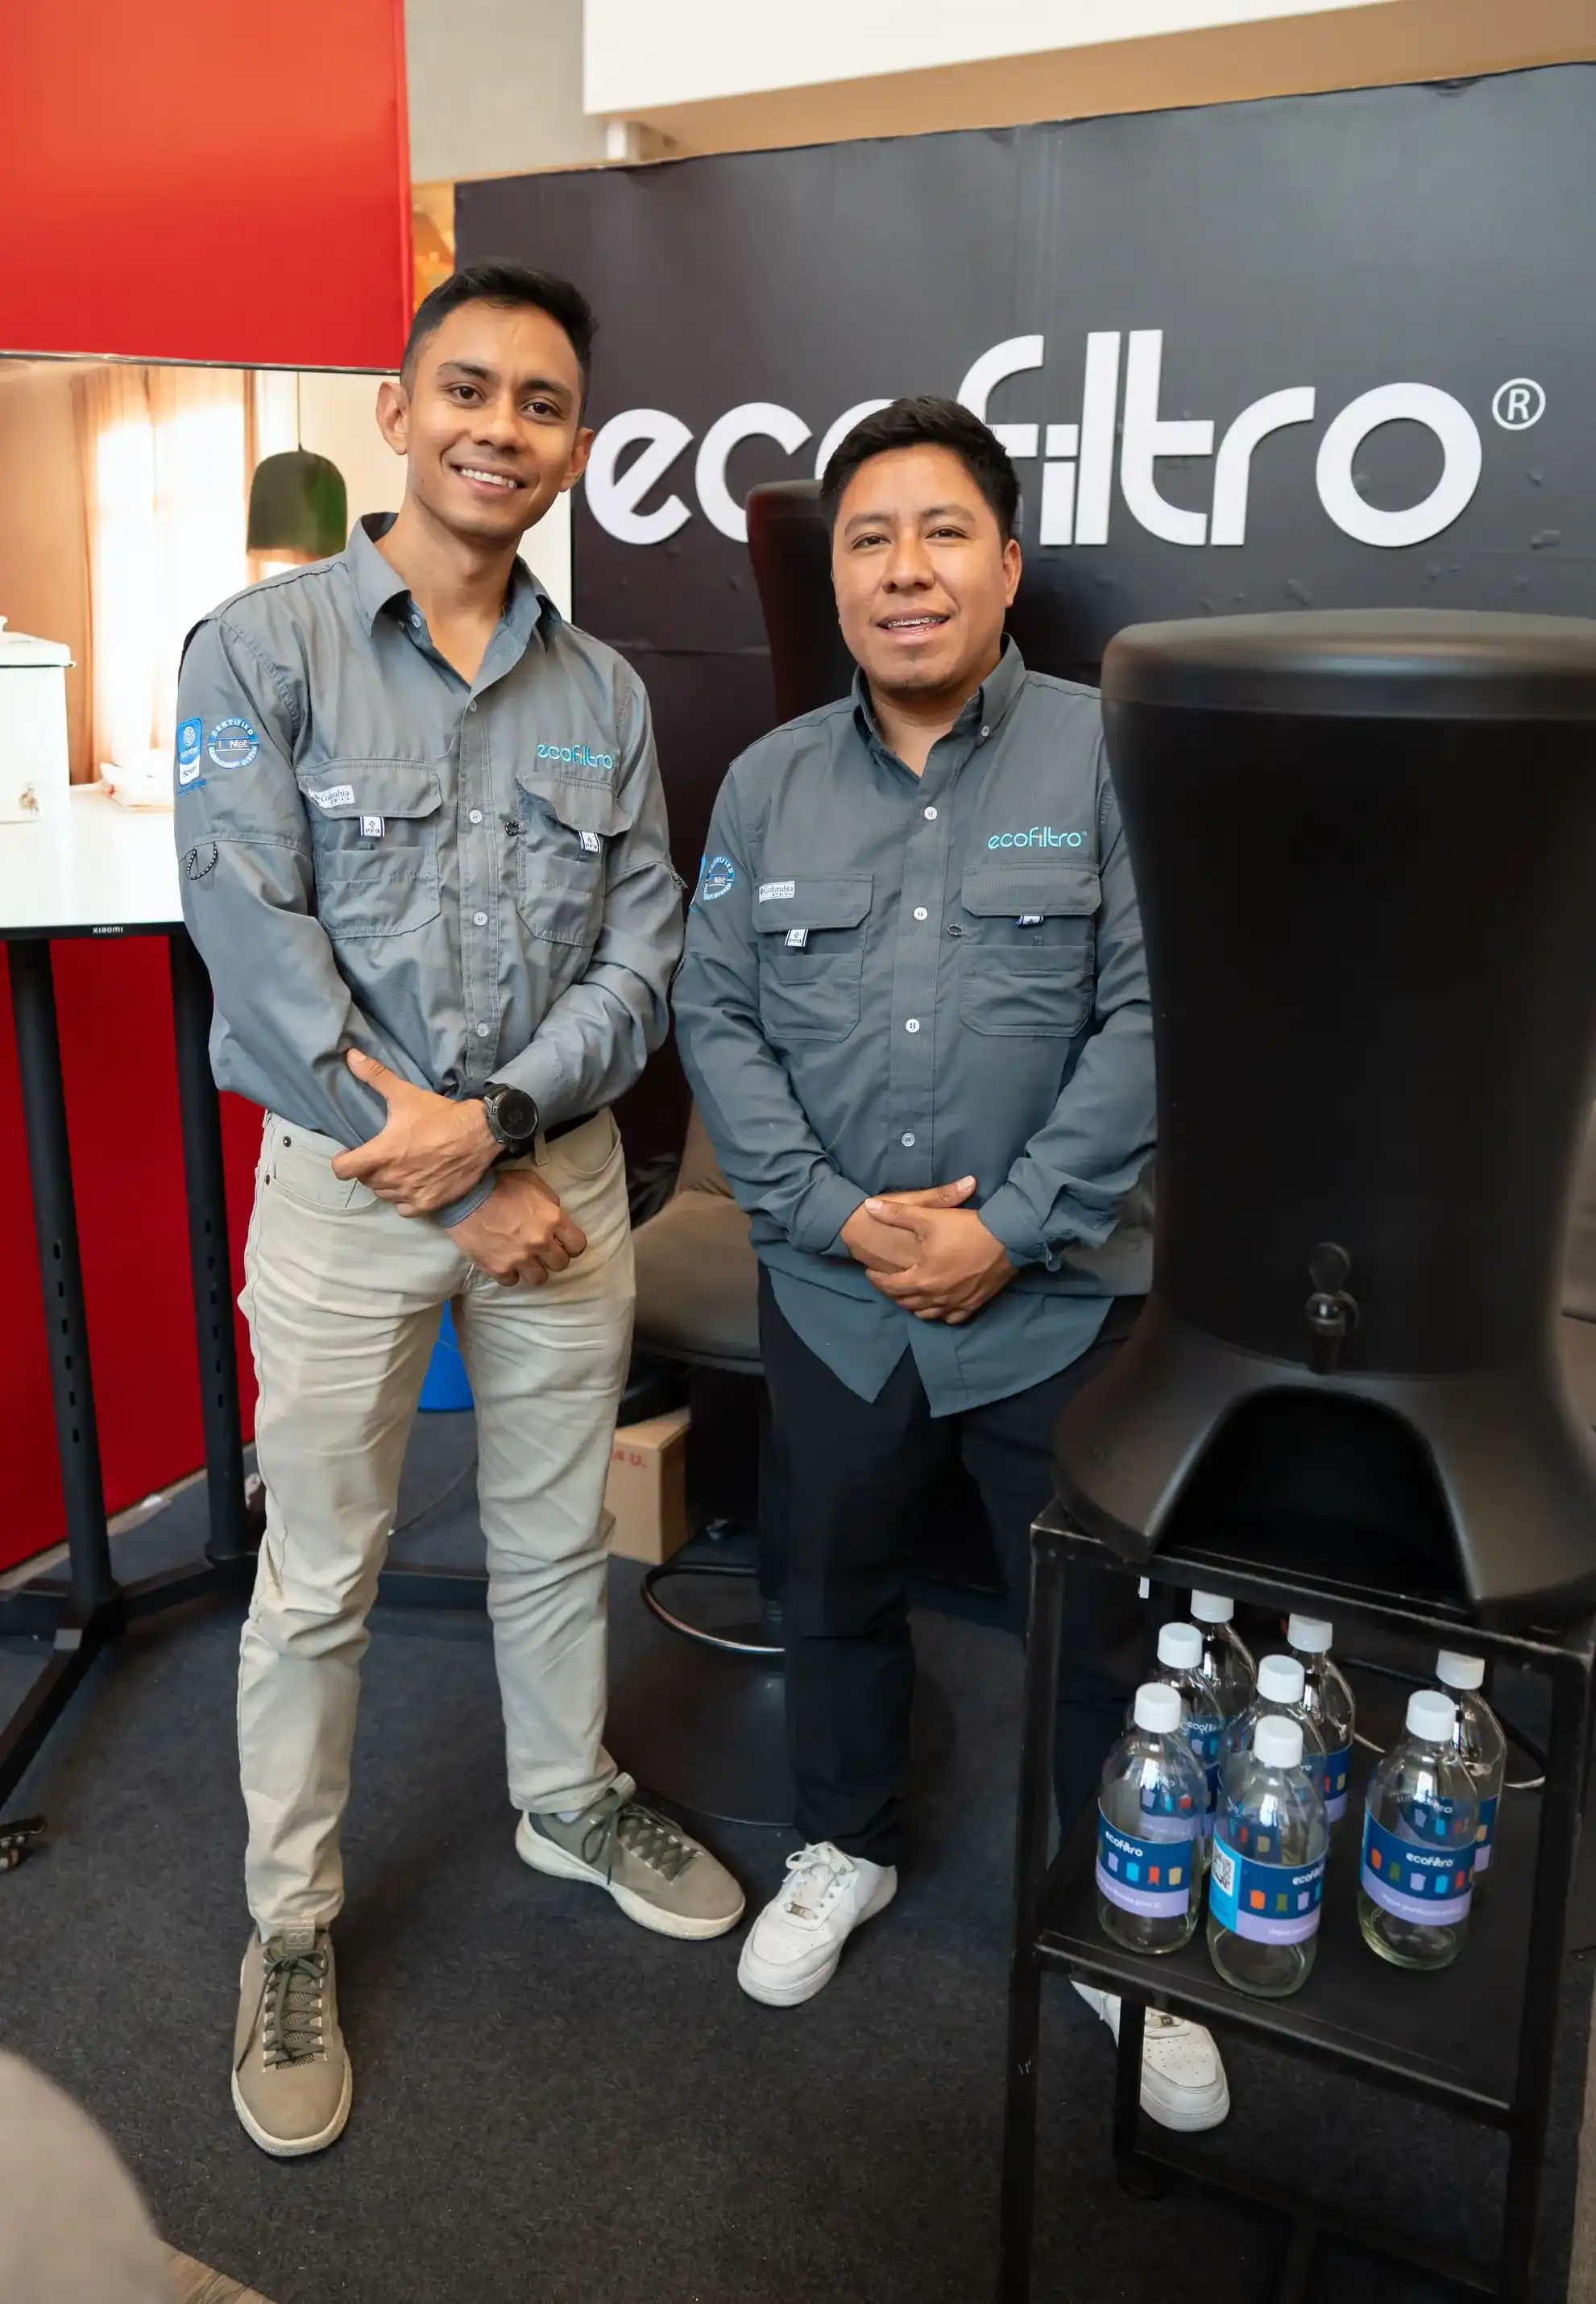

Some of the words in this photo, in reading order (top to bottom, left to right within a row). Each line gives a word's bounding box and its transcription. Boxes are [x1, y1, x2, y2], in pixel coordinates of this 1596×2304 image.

[584, 330, 1482, 548] ecfiltro
[537, 743, 613, 770] ecofiltro
[988, 826, 1082, 850] ecofiltro
[1105, 1830, 1143, 1858] ecofiltro
[1406, 1852, 1453, 1868] ecofiltro
